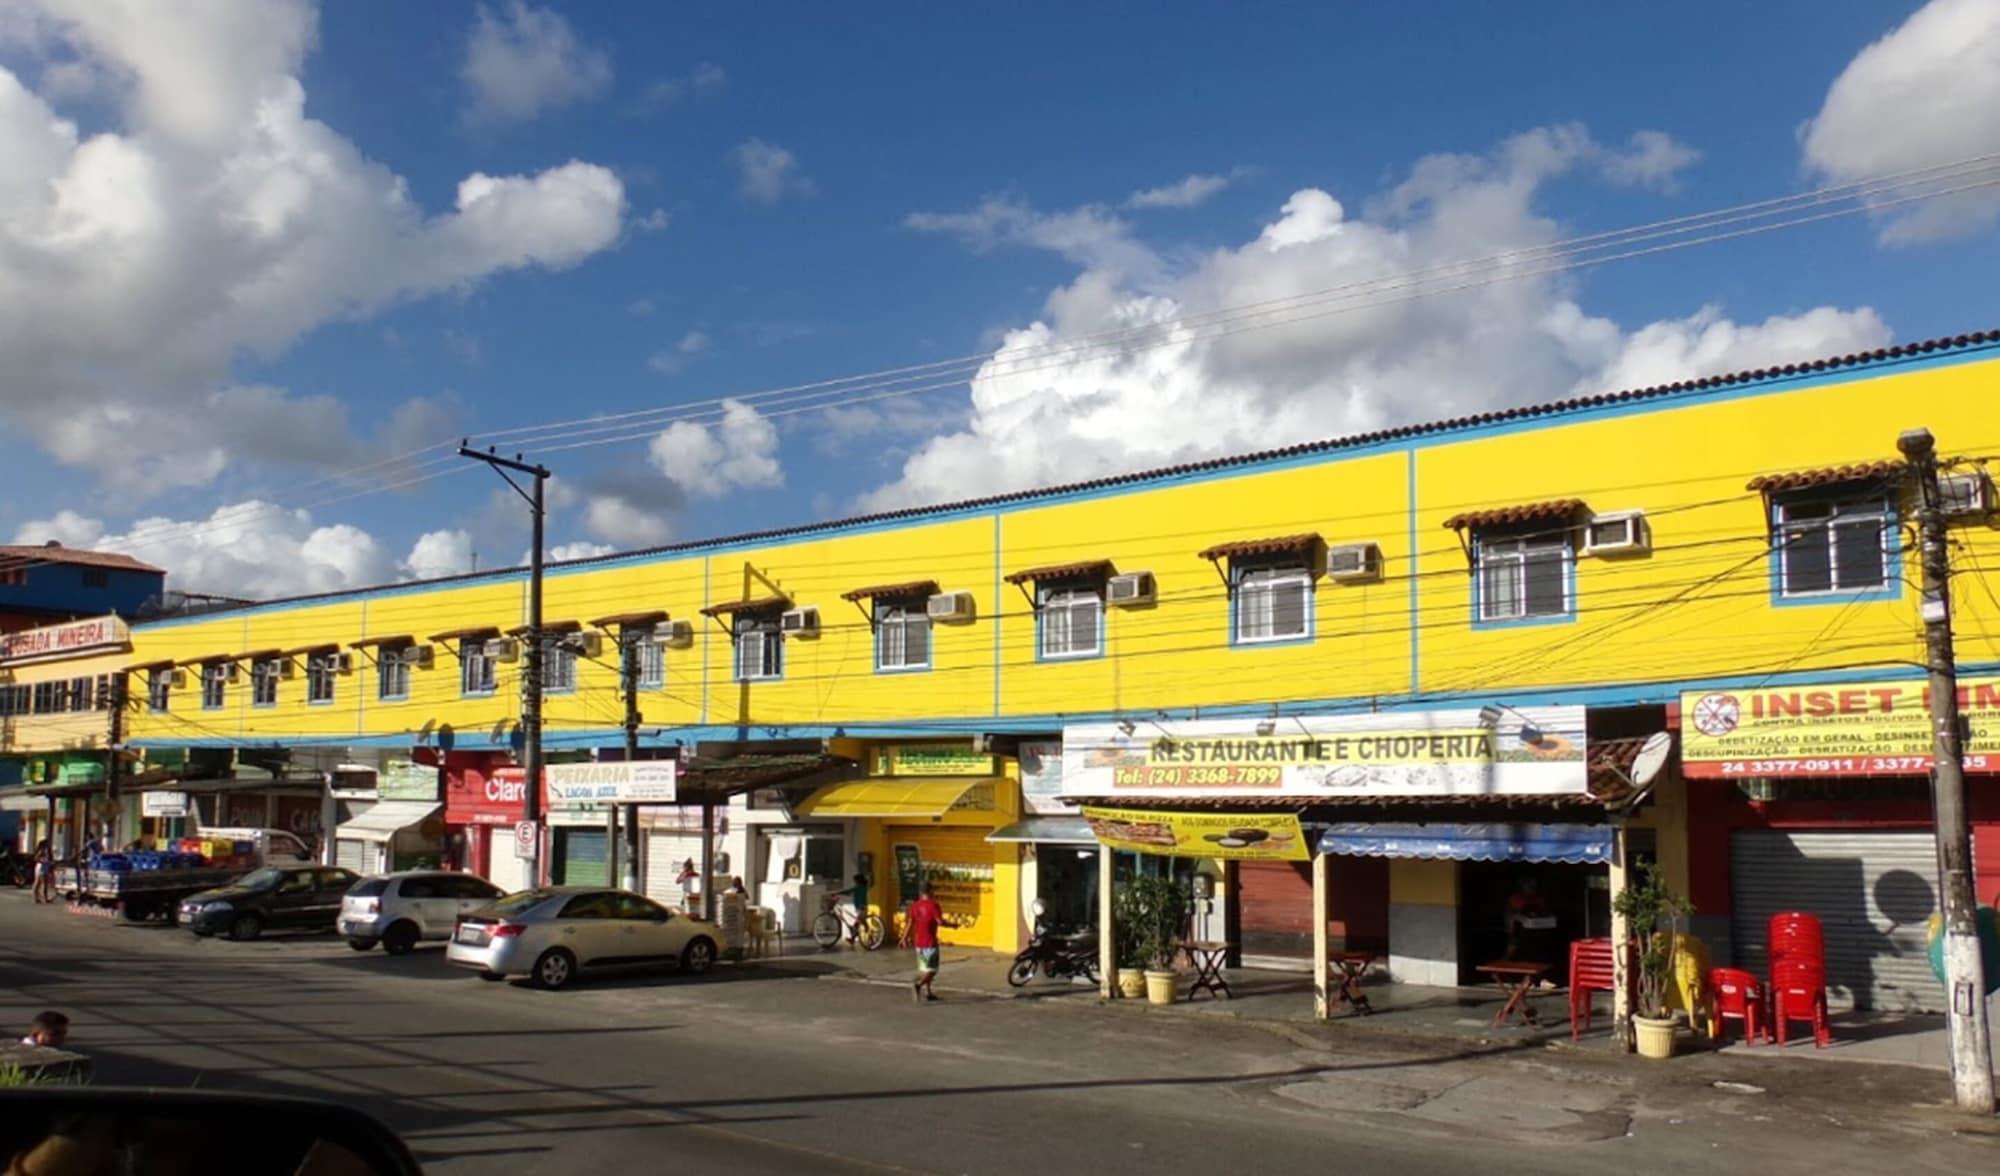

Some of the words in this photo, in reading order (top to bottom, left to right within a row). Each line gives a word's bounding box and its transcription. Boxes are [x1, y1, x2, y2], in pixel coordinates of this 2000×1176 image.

[1752, 688, 1902, 718] INSET
[1803, 735, 1821, 744] EM
[1824, 732, 1864, 743] GERAL
[1151, 737, 1331, 762] RESTAURANTE
[1335, 738, 1349, 760] E
[1358, 734, 1493, 760] CHOPERIA
[1722, 762, 1745, 773] 24
[1751, 759, 1854, 773] 3377-0911
[1116, 769, 1143, 784] Tel:
[1148, 768, 1182, 785] (24)
[1187, 767, 1280, 784] 3368-7899
[521, 826, 530, 841] E
